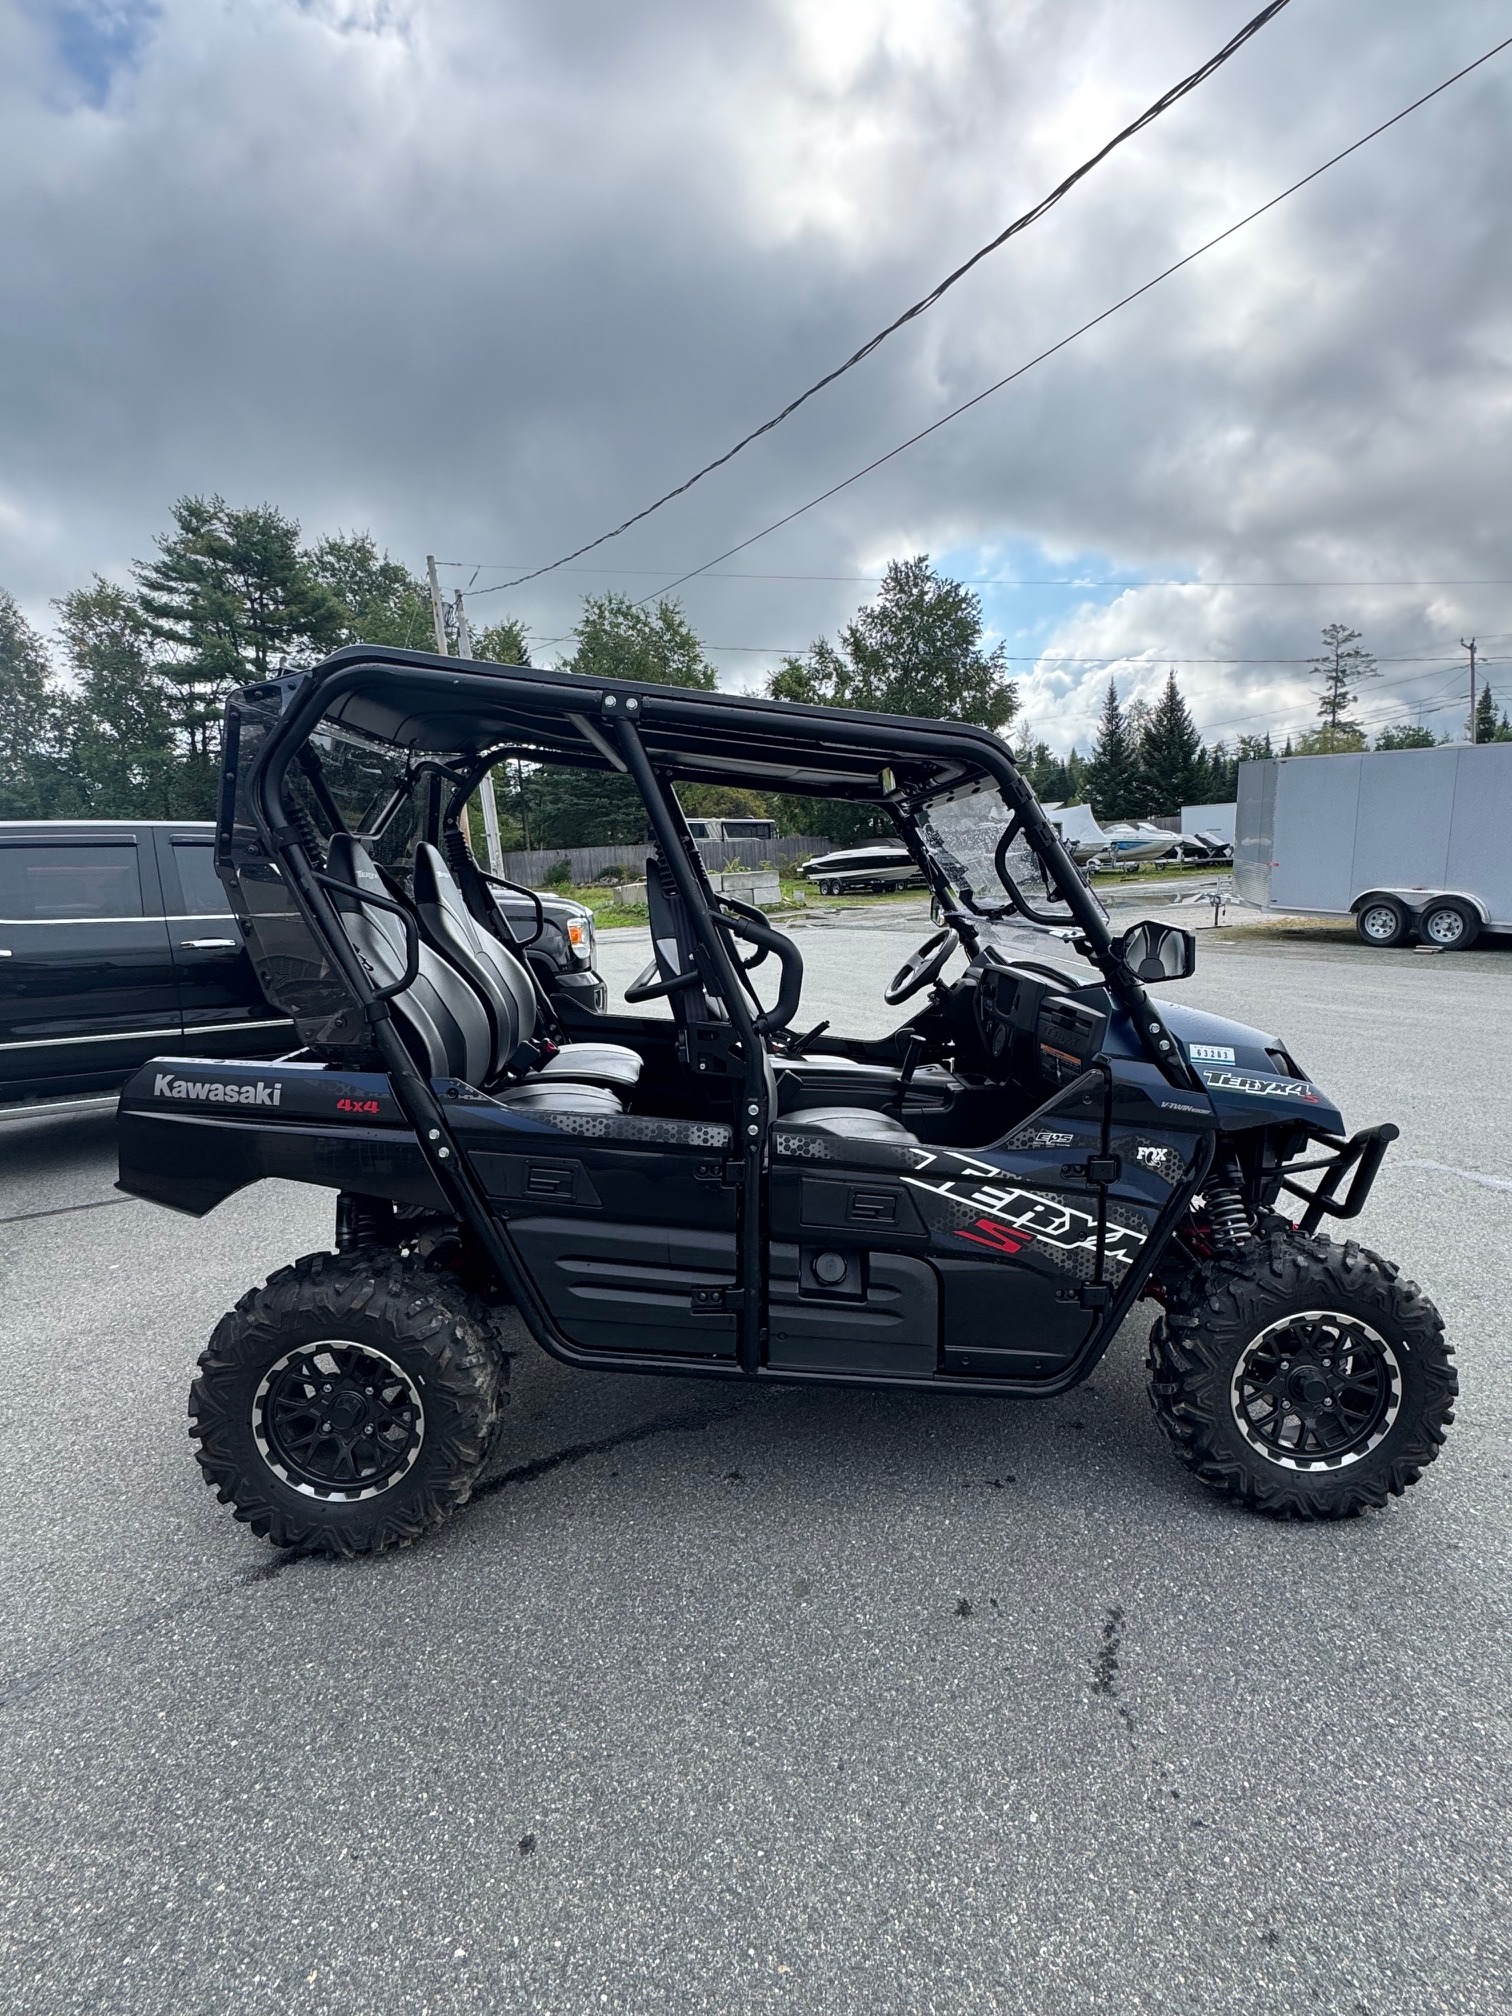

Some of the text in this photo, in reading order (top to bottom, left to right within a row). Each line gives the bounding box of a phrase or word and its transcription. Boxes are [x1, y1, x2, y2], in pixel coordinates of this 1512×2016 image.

[153, 1072, 282, 1106] Kawasaki
[336, 1098, 379, 1114] 4x4
[1136, 1146, 1168, 1168] FOX
